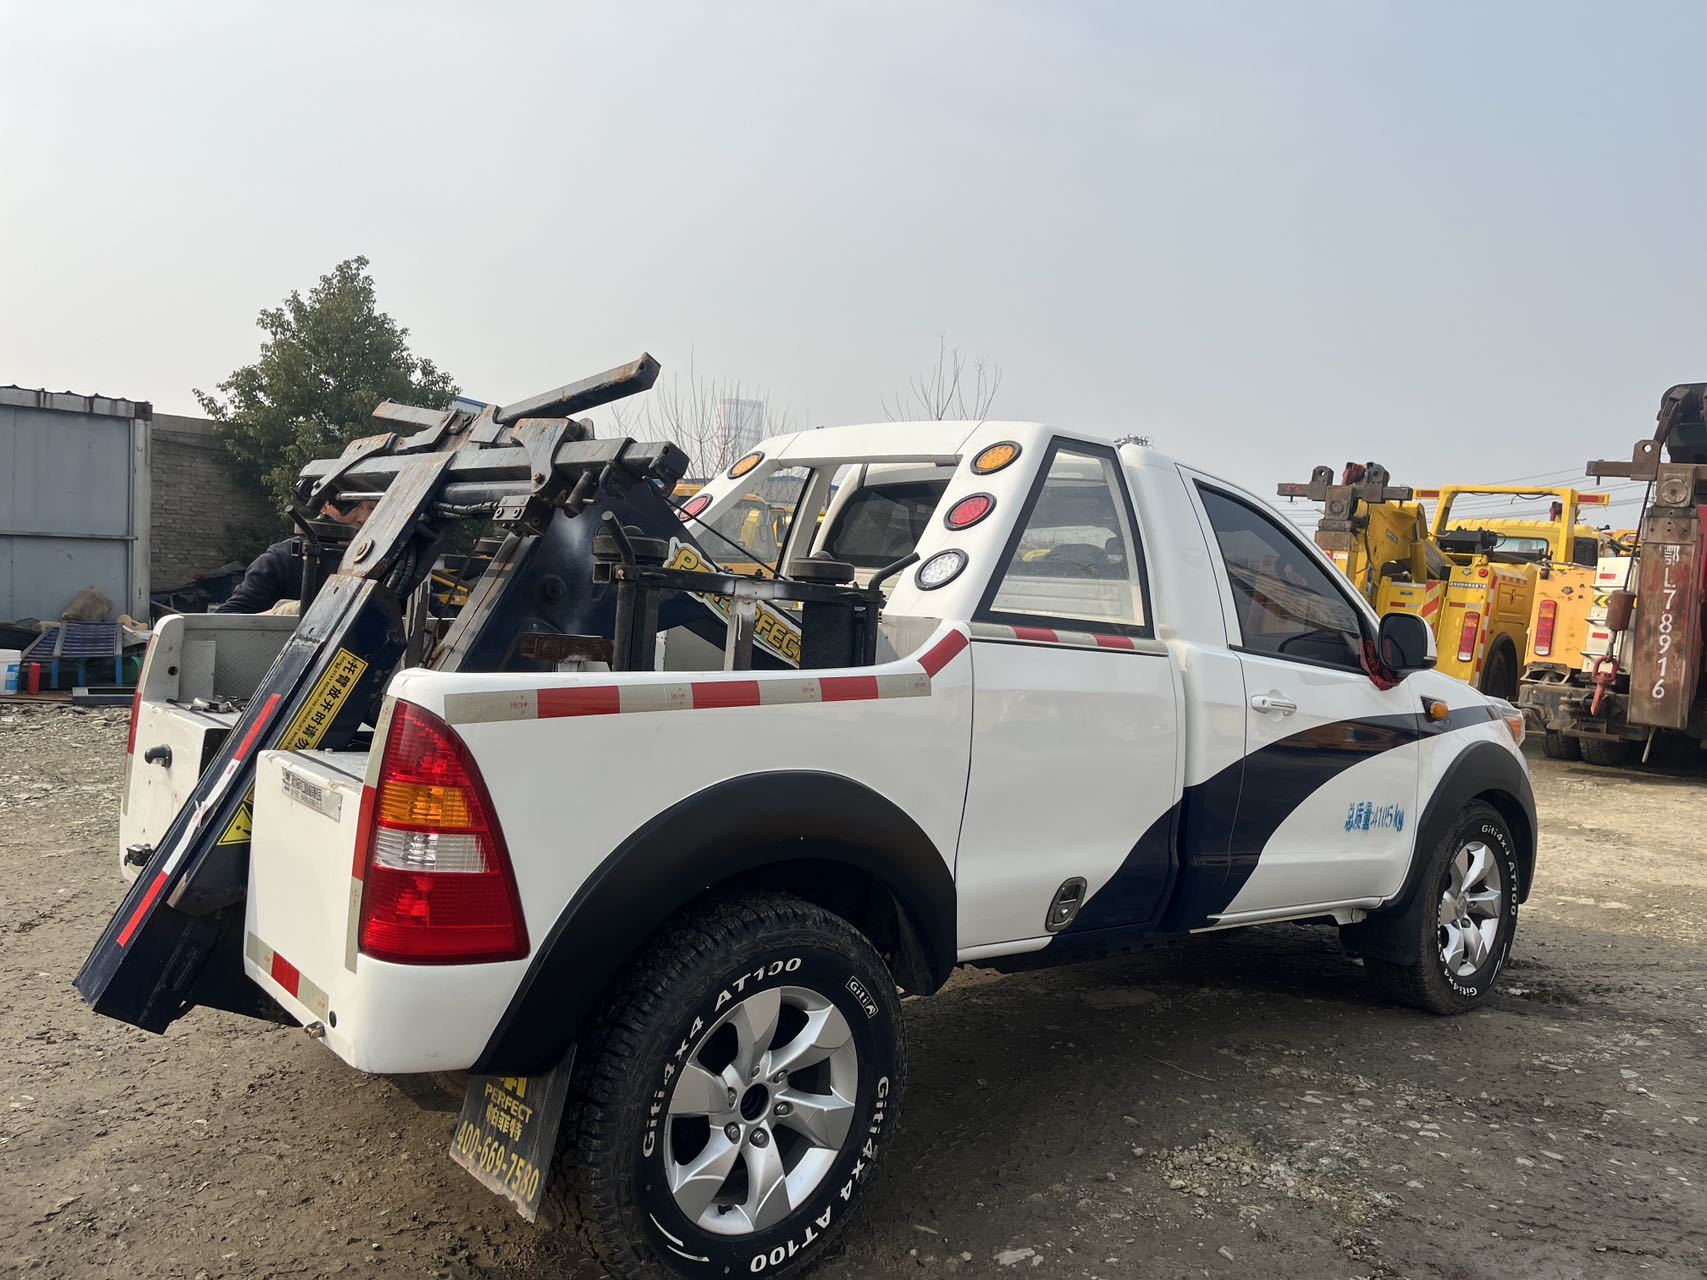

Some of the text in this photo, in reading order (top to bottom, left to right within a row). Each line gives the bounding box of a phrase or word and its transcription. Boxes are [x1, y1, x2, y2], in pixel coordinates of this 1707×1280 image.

[1508, 861, 1519, 916] AT100
[714, 957, 802, 1012] AT100
[850, 981, 870, 1003] Giti
[484, 1082, 533, 1123] PERFECT
[486, 1102, 523, 1142] 帕菲特
[457, 1120, 540, 1202] 400-669-7580
[750, 1206, 832, 1273] AT100
